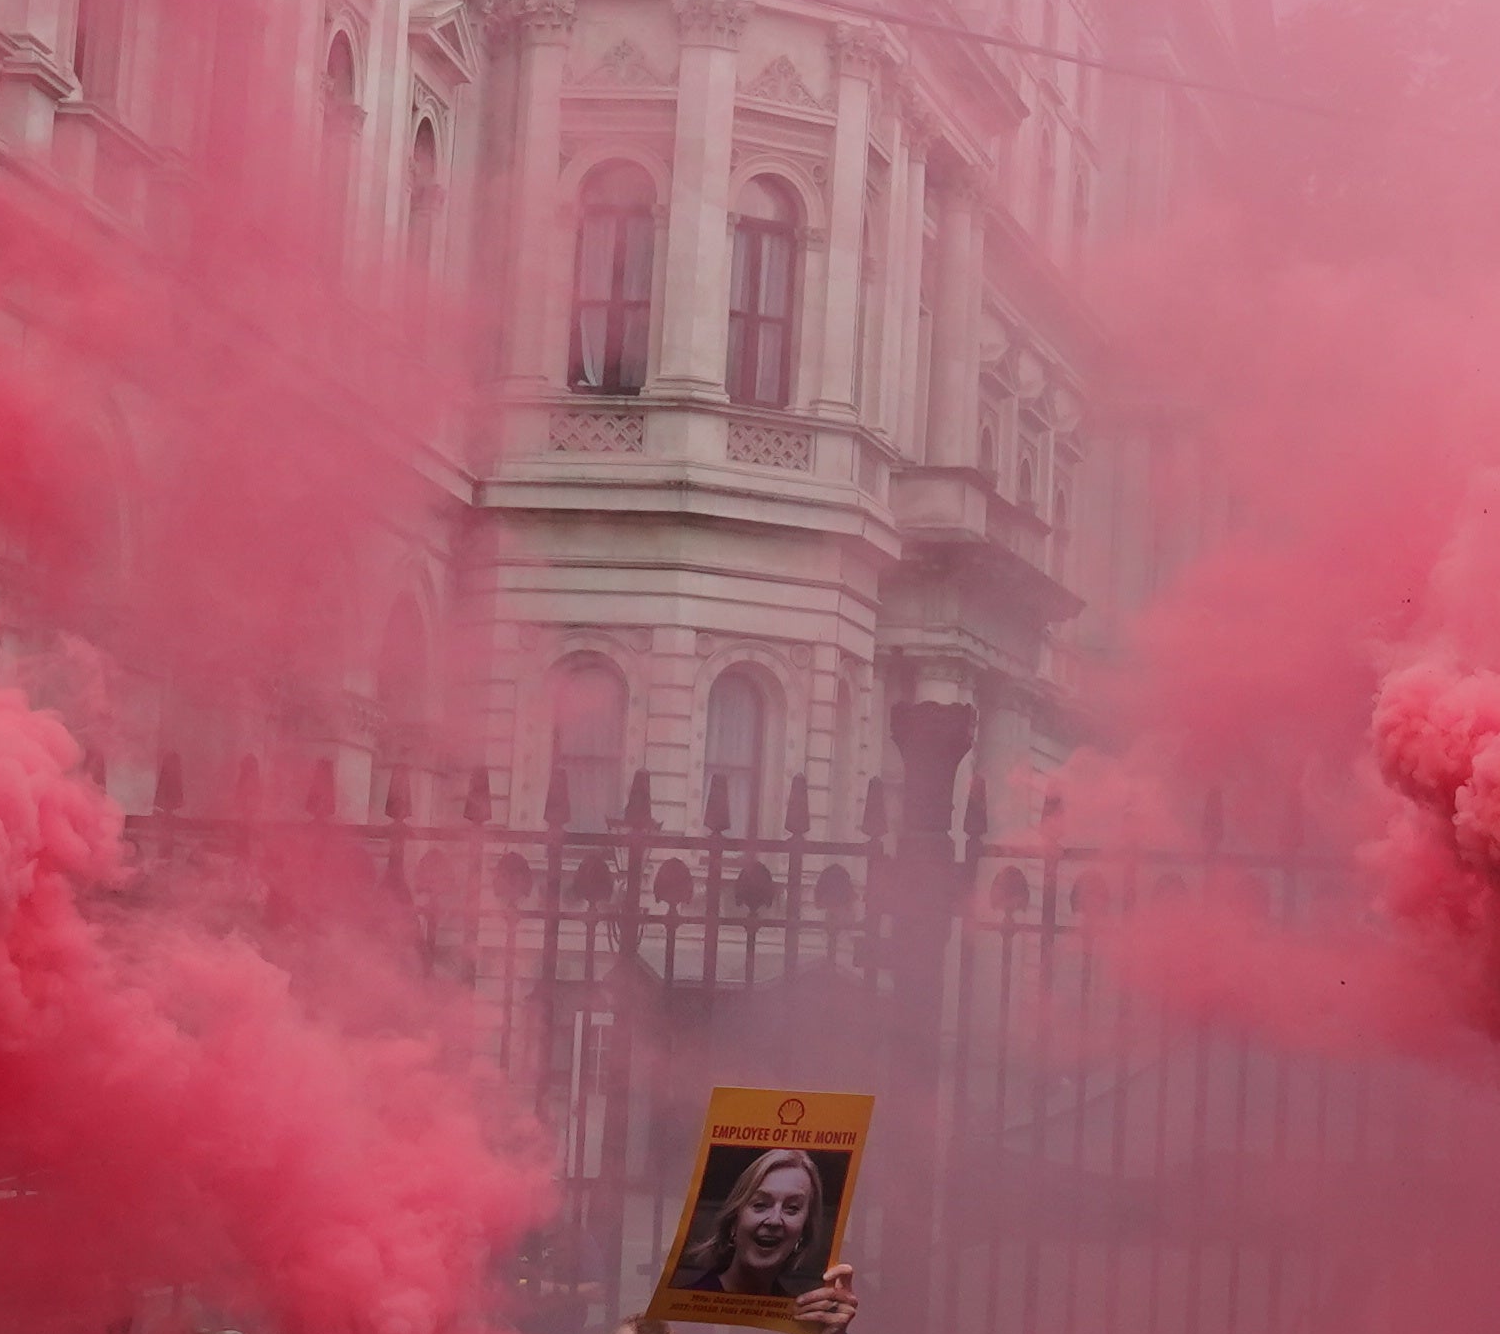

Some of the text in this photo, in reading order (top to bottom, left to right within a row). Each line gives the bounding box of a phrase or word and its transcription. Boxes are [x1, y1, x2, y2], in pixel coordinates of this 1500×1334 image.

[712, 1125, 857, 1145] EMPLOYEE OF THE MONTH
